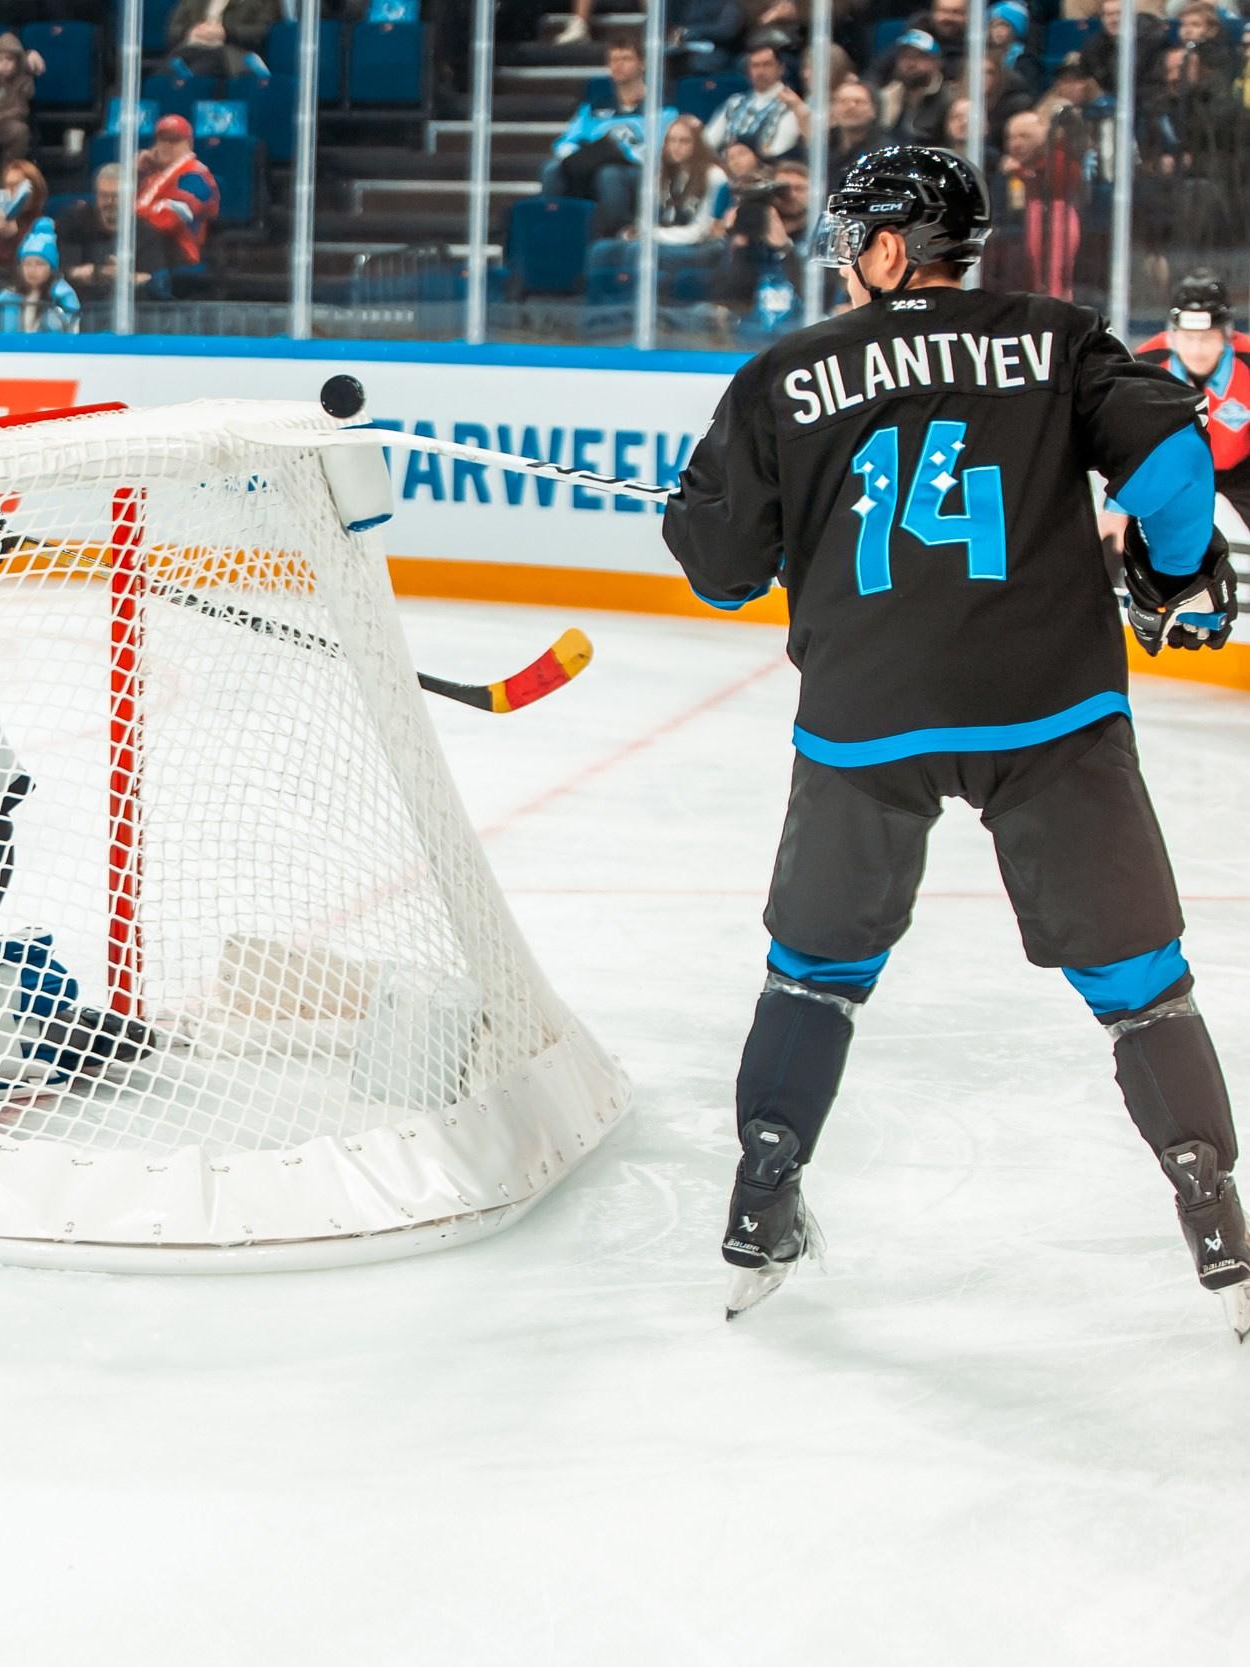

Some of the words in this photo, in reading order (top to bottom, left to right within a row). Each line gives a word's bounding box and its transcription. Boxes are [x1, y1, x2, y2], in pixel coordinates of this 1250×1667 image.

[869, 203, 904, 212] CCM
[783, 331, 1054, 425] SILANTYEV
[851, 420, 1007, 596] 14
